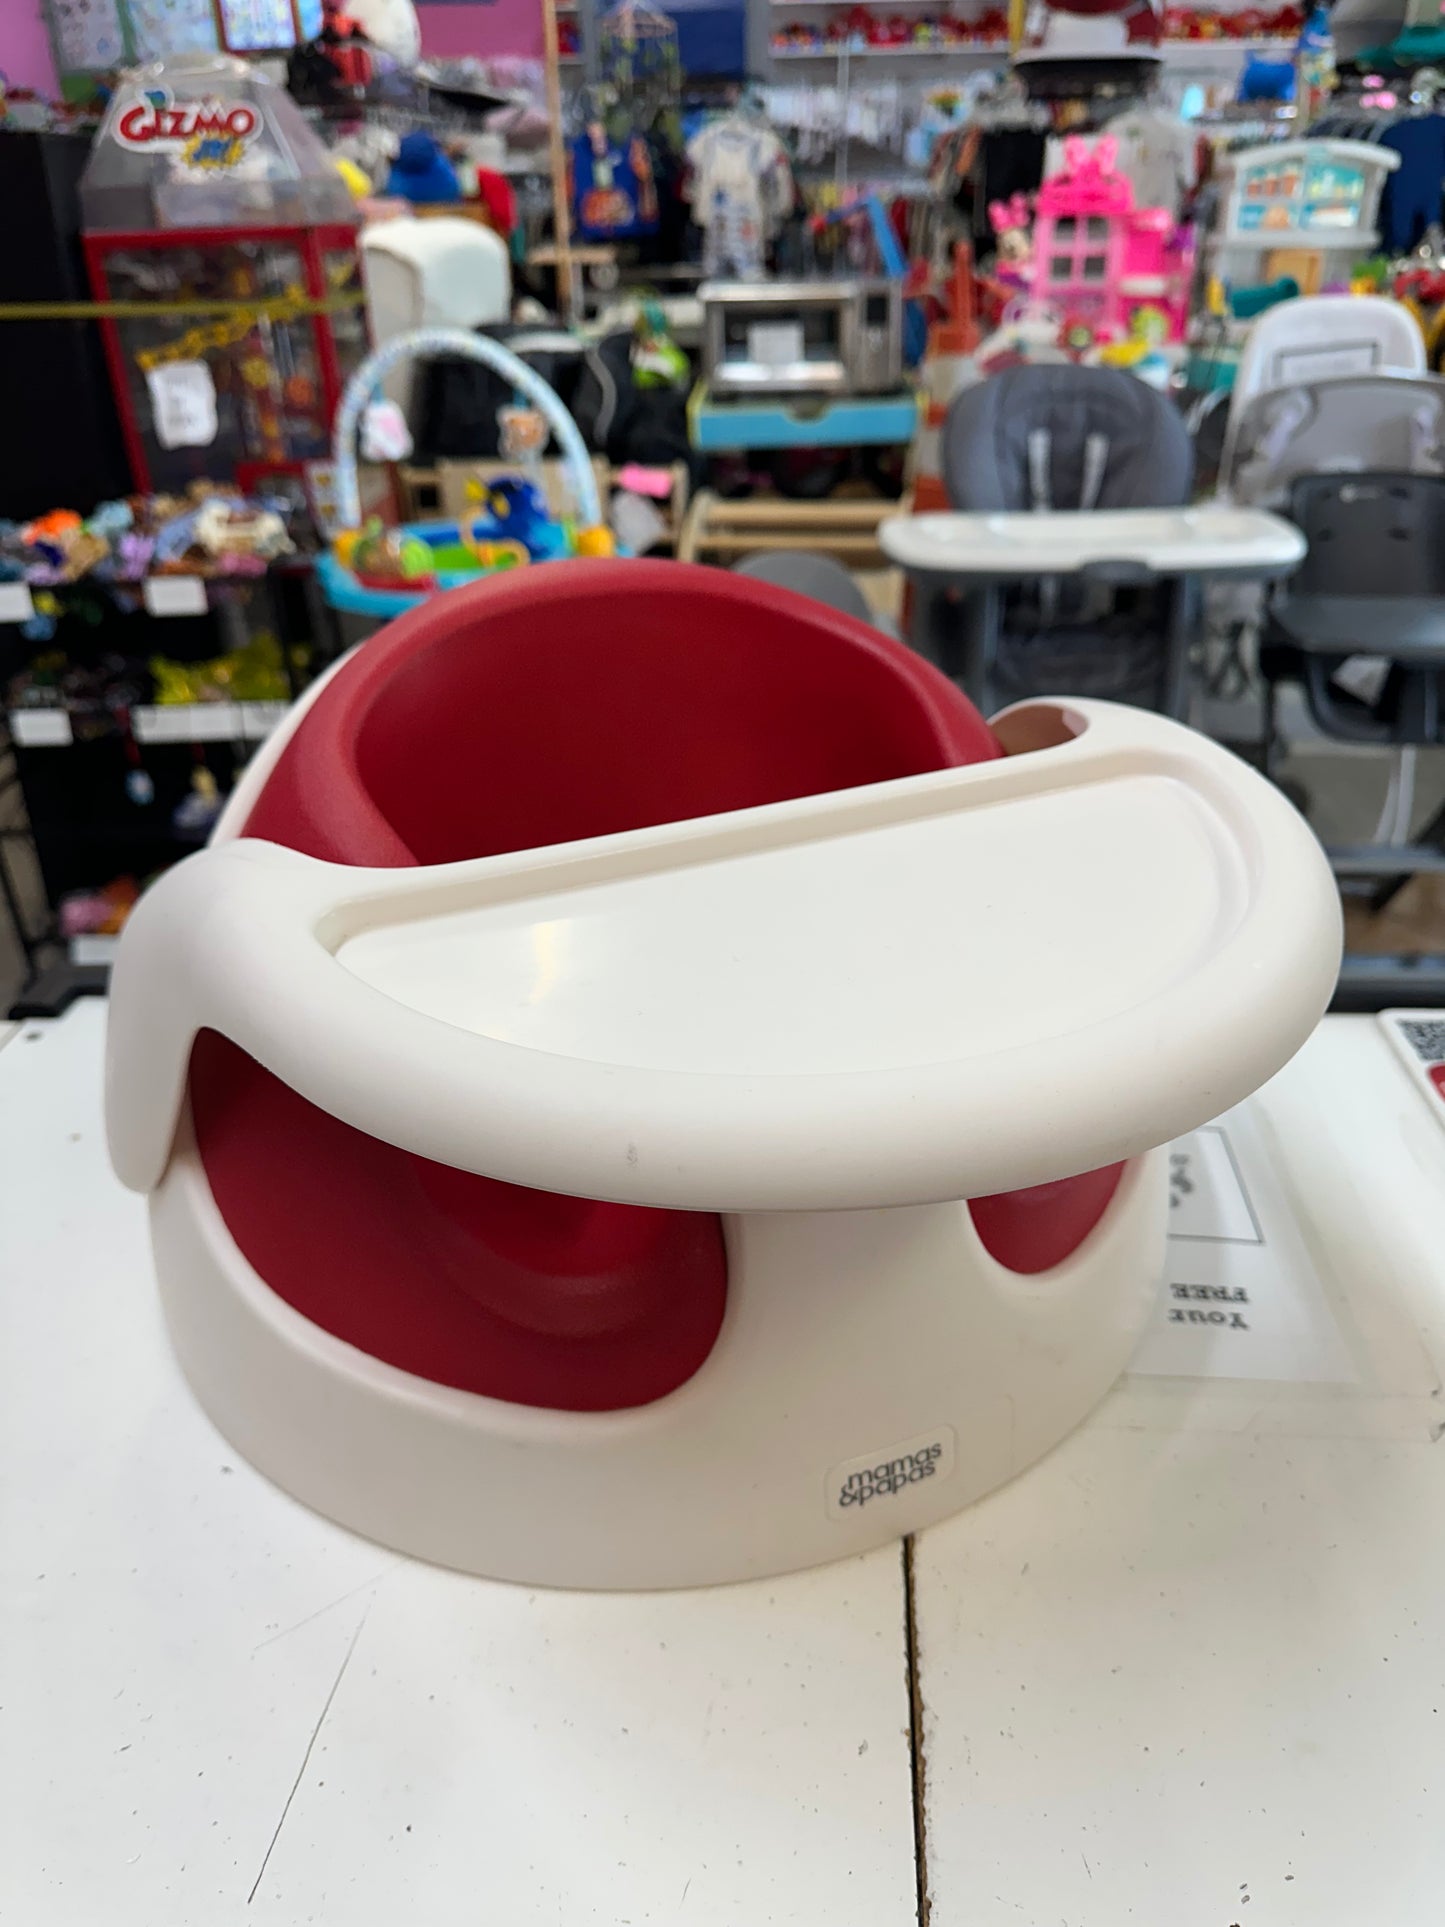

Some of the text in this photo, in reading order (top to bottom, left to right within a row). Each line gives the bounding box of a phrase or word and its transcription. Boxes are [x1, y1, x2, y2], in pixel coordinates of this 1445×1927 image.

[1169, 1283, 1249, 1303] FREE
[1167, 1308, 1249, 1330] Your
[848, 1443, 942, 1489] mamas
